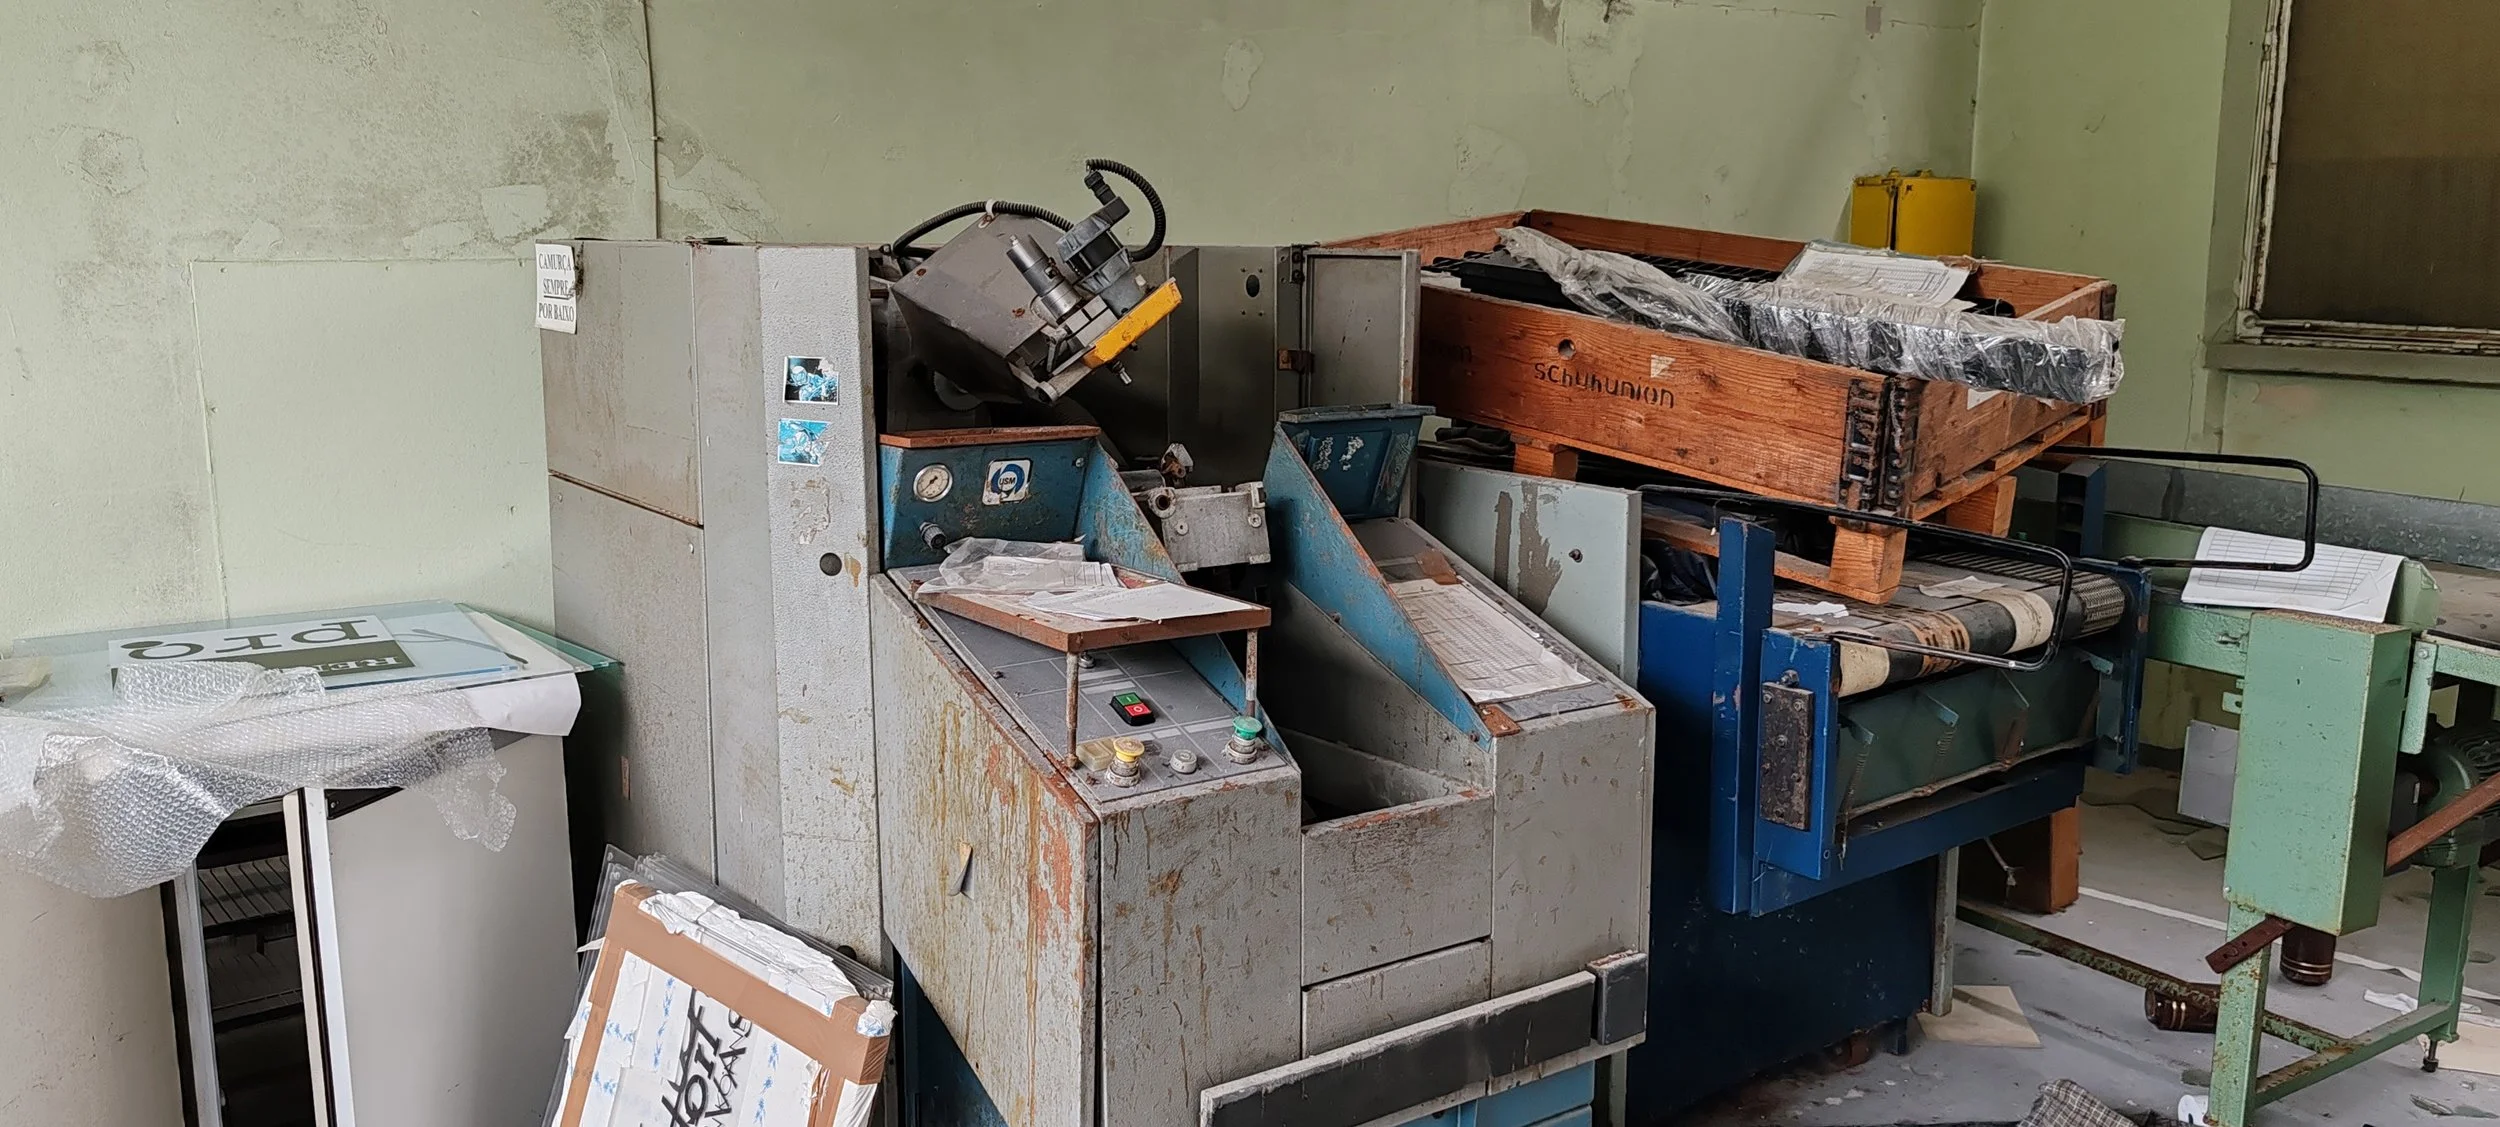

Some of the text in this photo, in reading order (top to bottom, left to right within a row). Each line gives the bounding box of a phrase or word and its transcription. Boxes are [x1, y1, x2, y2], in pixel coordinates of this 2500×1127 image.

[538, 253, 571, 275] CAMURÇA
[543, 278, 569, 296] SEMPRE
[538, 302, 575, 322] POR BAIXO
[999, 477, 1016, 486] USM
